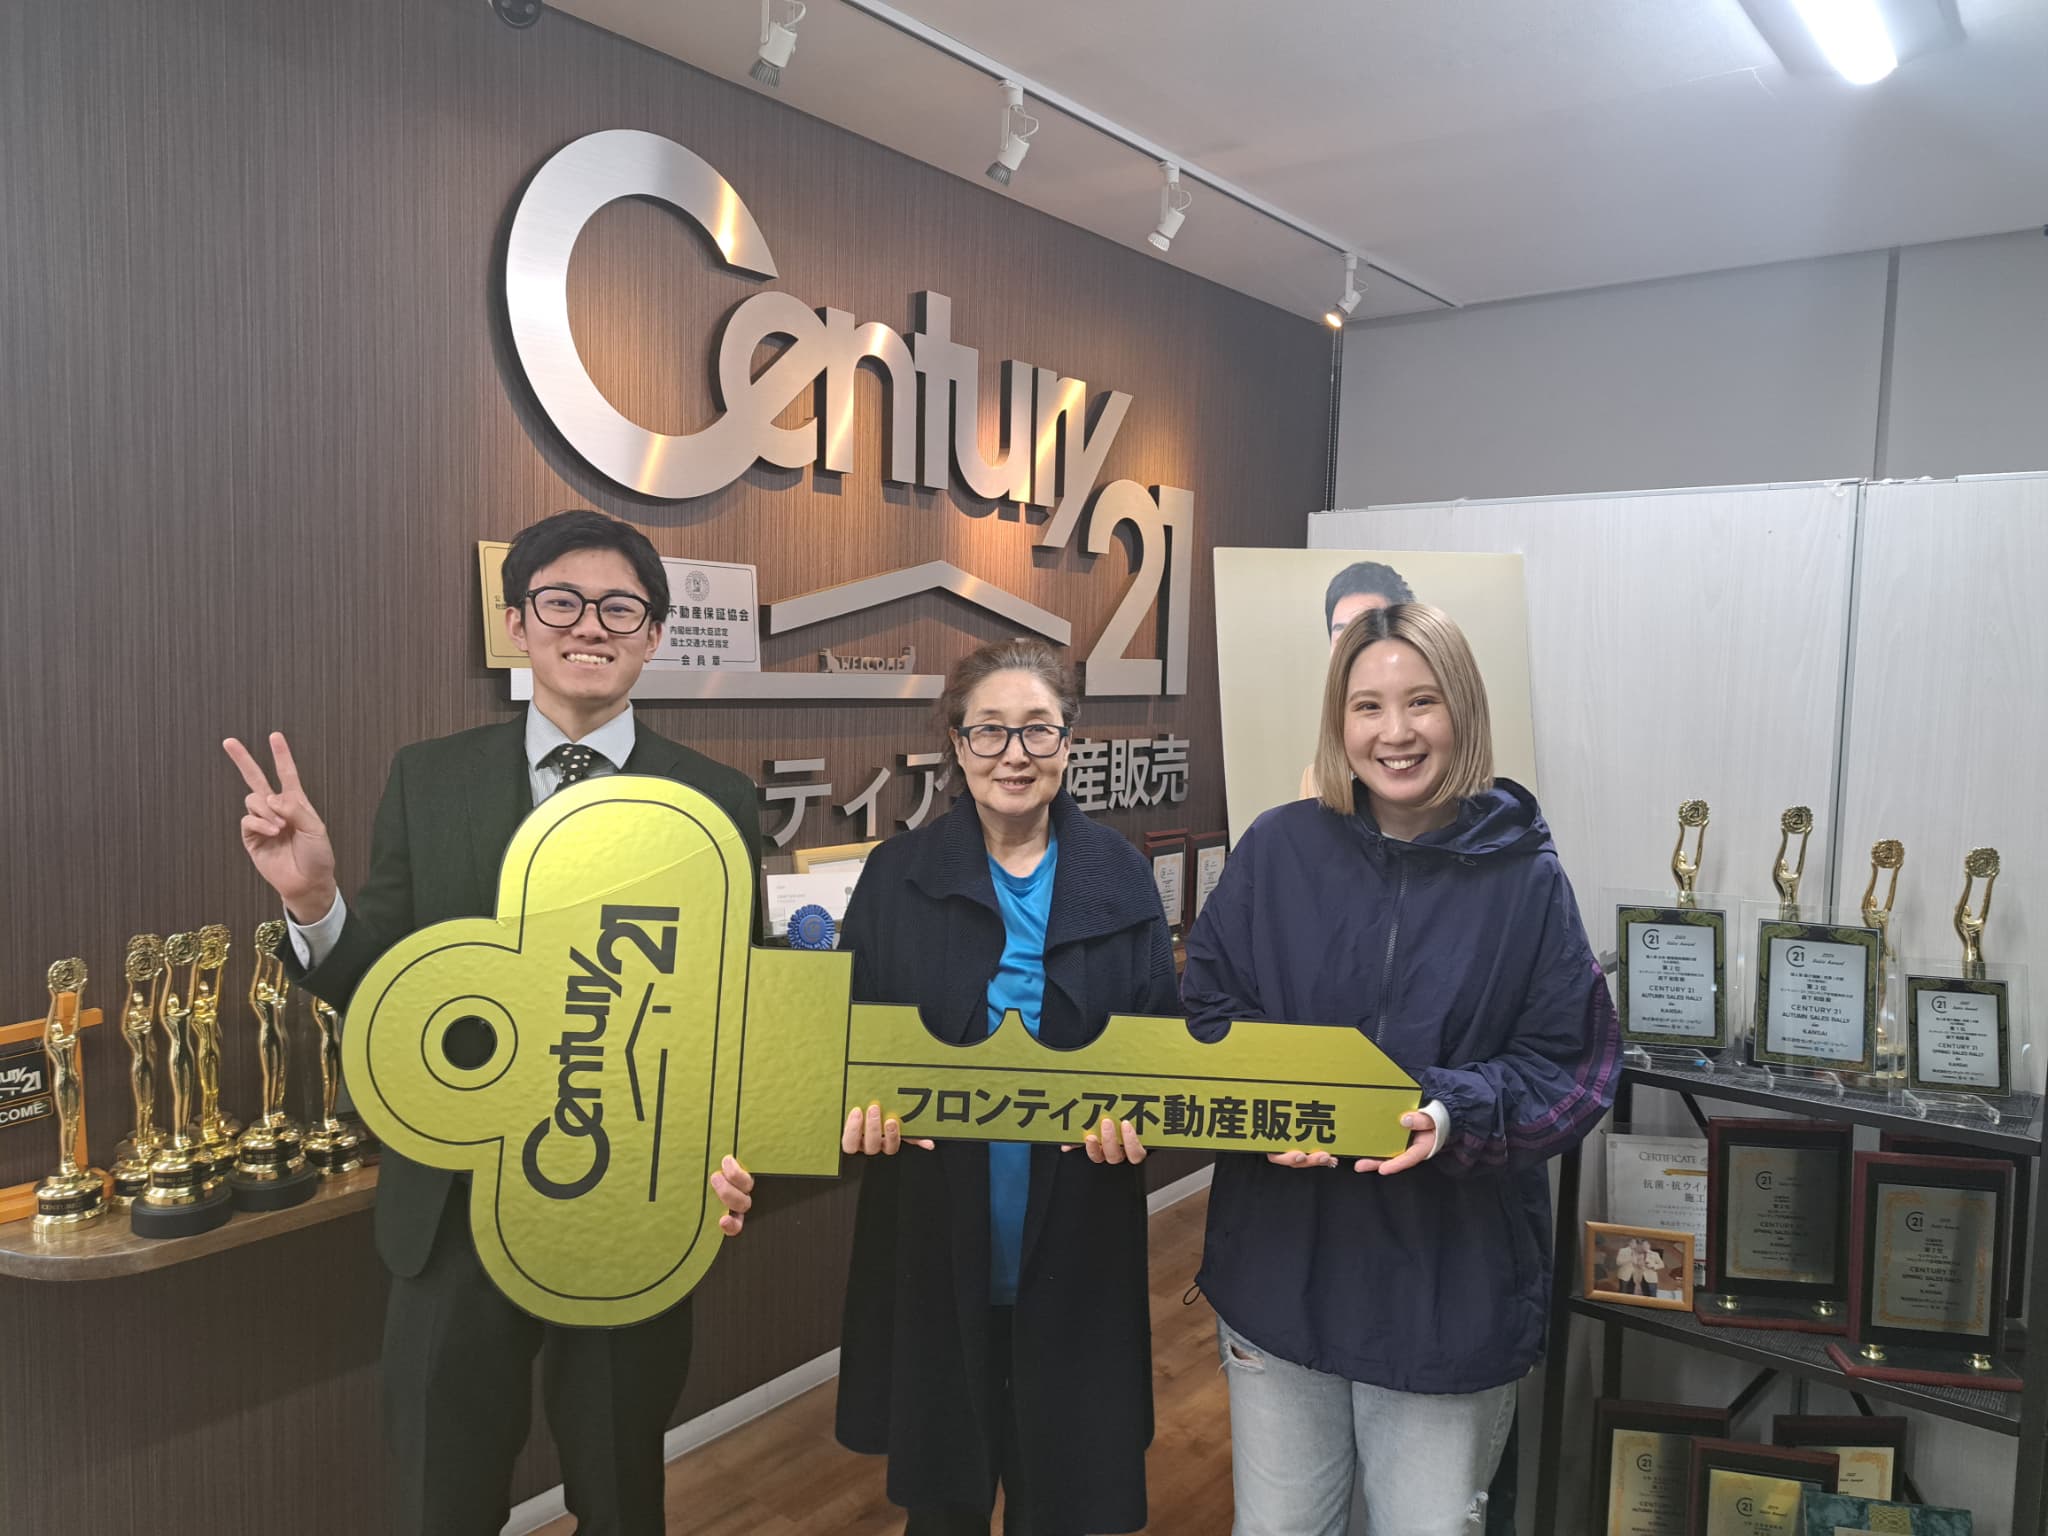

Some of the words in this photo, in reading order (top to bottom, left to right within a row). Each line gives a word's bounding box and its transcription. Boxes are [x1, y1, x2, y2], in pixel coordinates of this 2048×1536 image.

[505, 128, 1133, 549] Century
[1084, 478, 1195, 697] 21
[670, 637, 729, 649] 国土交通大臣指定
[1791, 1004, 1832, 1014] CENTURY
[521, 945, 623, 1201] Century
[596, 903, 681, 975] 21
[20, 1070, 42, 1093] 21
[897, 1086, 1337, 1145] フロンティア不動産販売
